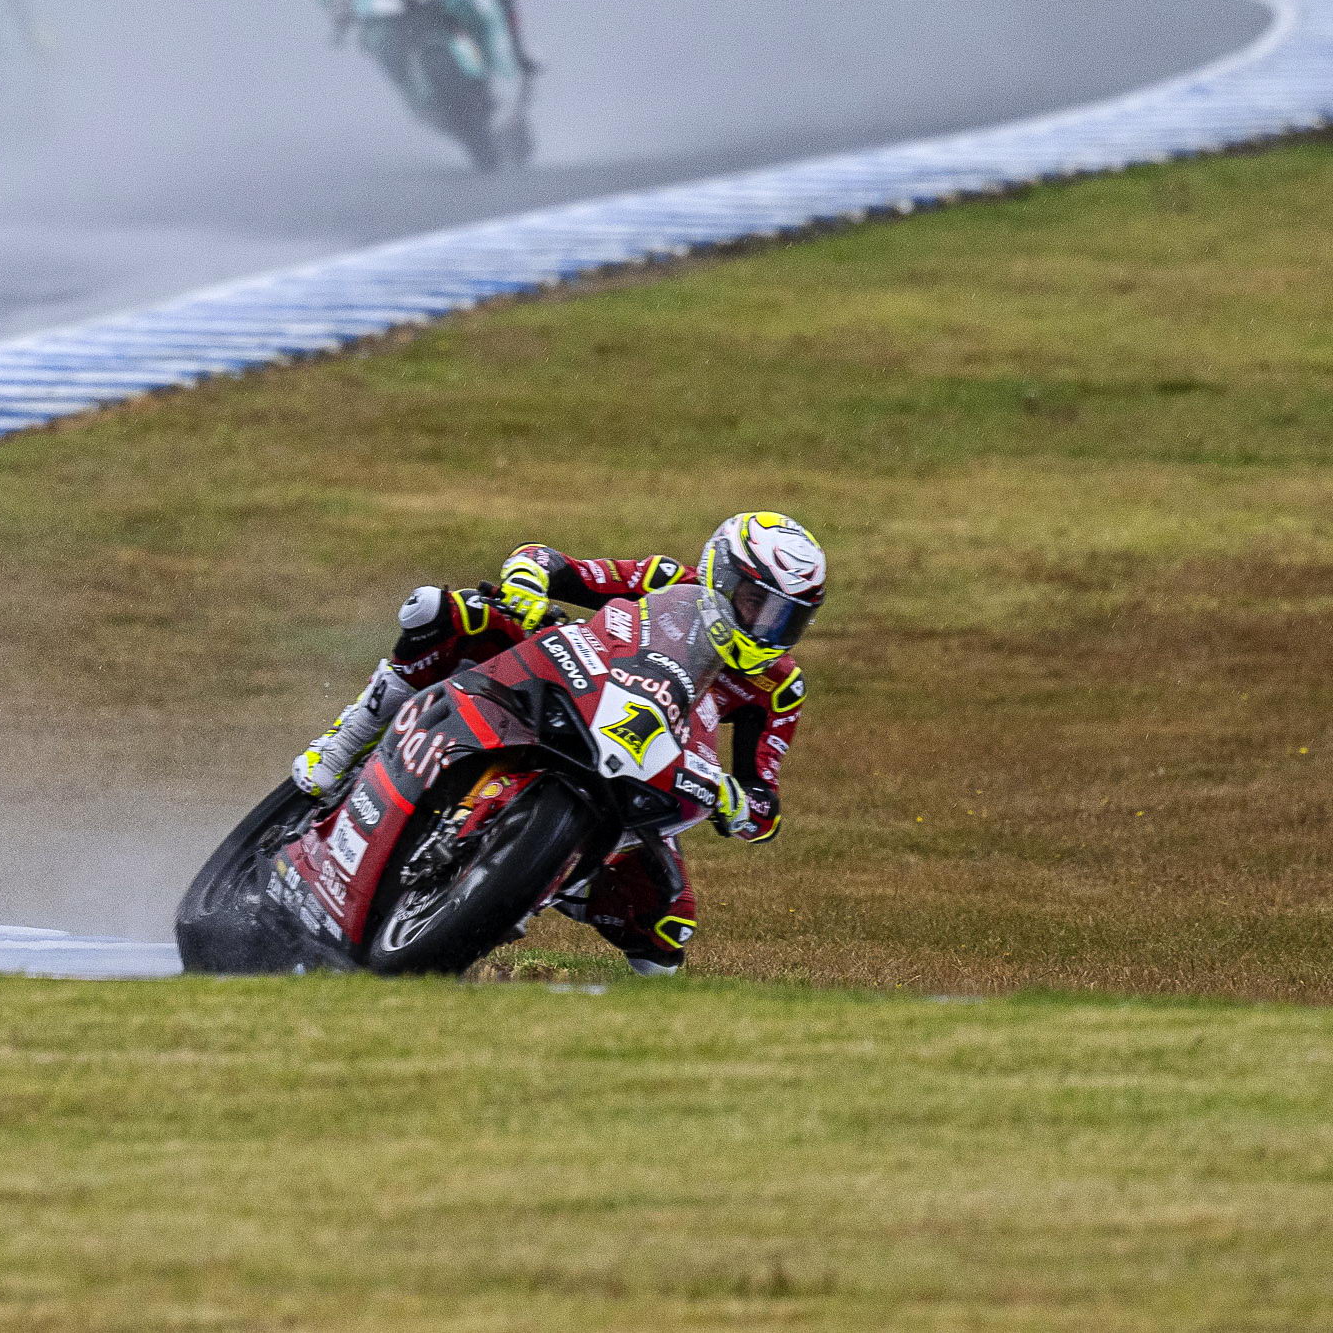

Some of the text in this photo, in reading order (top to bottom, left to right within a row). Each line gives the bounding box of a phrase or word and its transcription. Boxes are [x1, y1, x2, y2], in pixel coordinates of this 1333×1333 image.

[541, 635, 589, 690] Lenovo
[599, 701, 667, 768] 1
[610, 667, 691, 743] aruba.it
[675, 773, 717, 807] Lenovo
